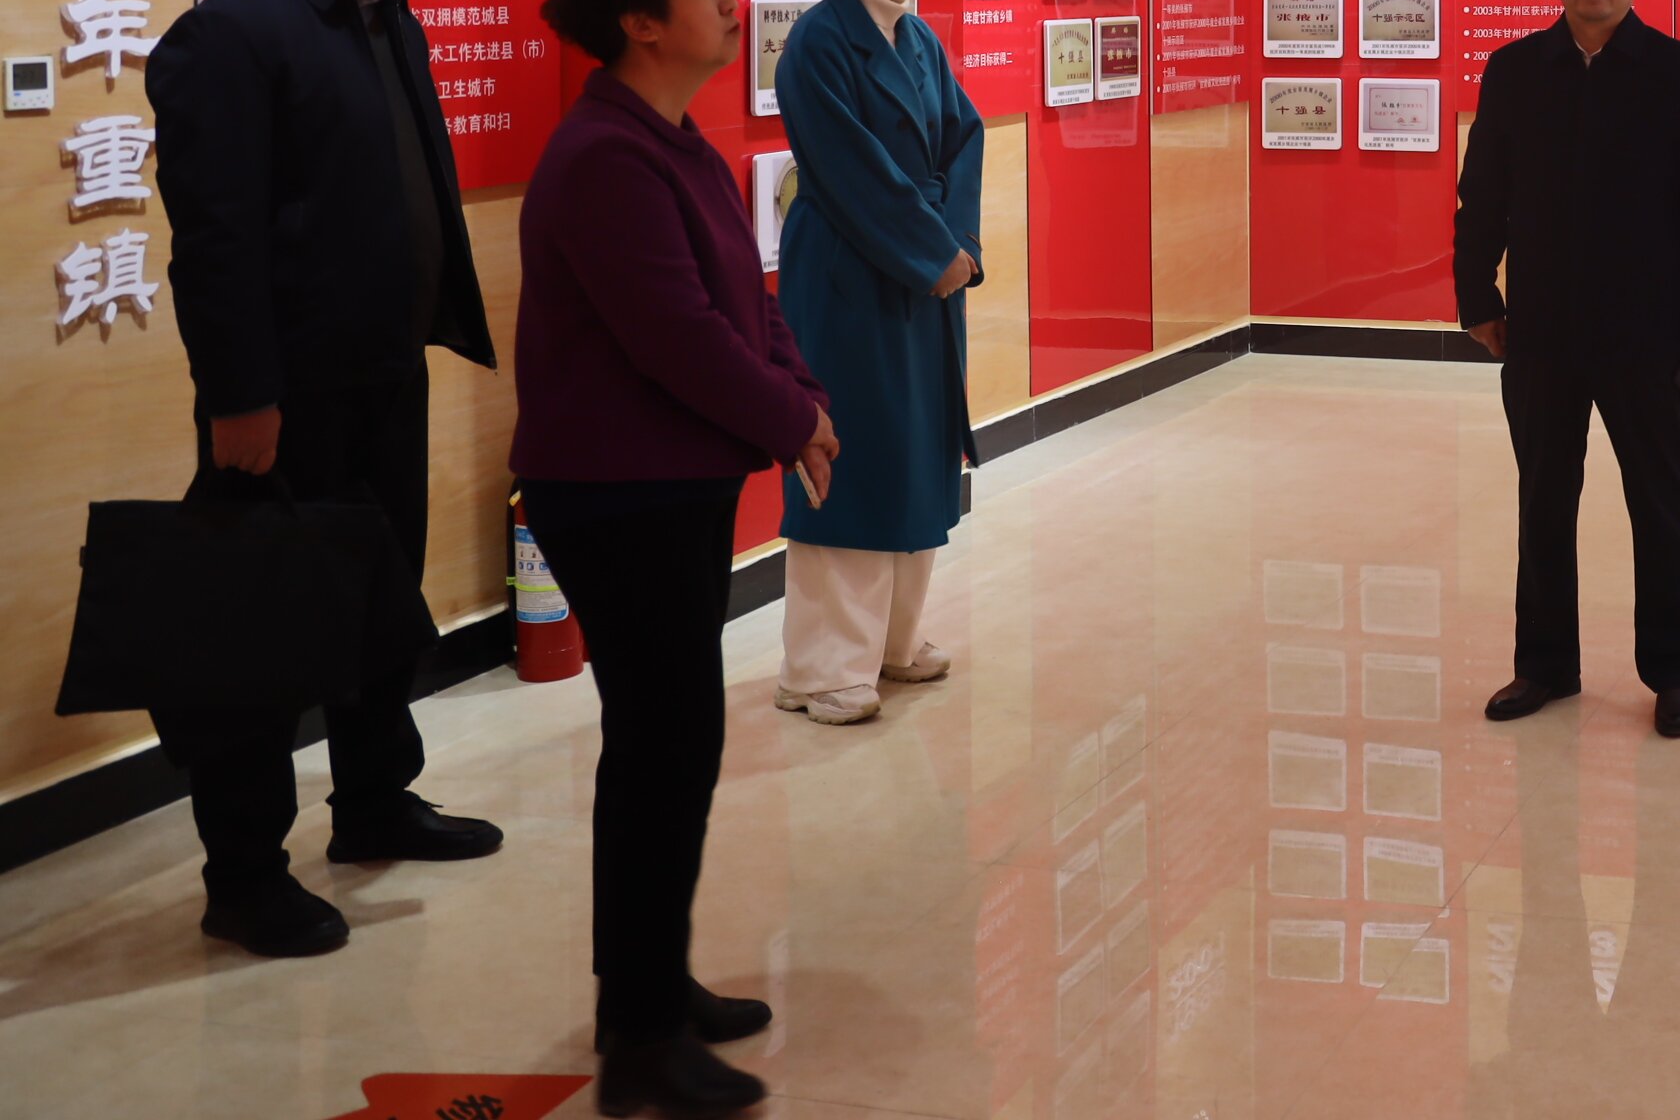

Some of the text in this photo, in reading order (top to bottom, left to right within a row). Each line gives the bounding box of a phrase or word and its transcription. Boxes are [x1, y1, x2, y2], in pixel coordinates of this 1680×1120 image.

[410, 6, 510, 27] 双拥模范城县
